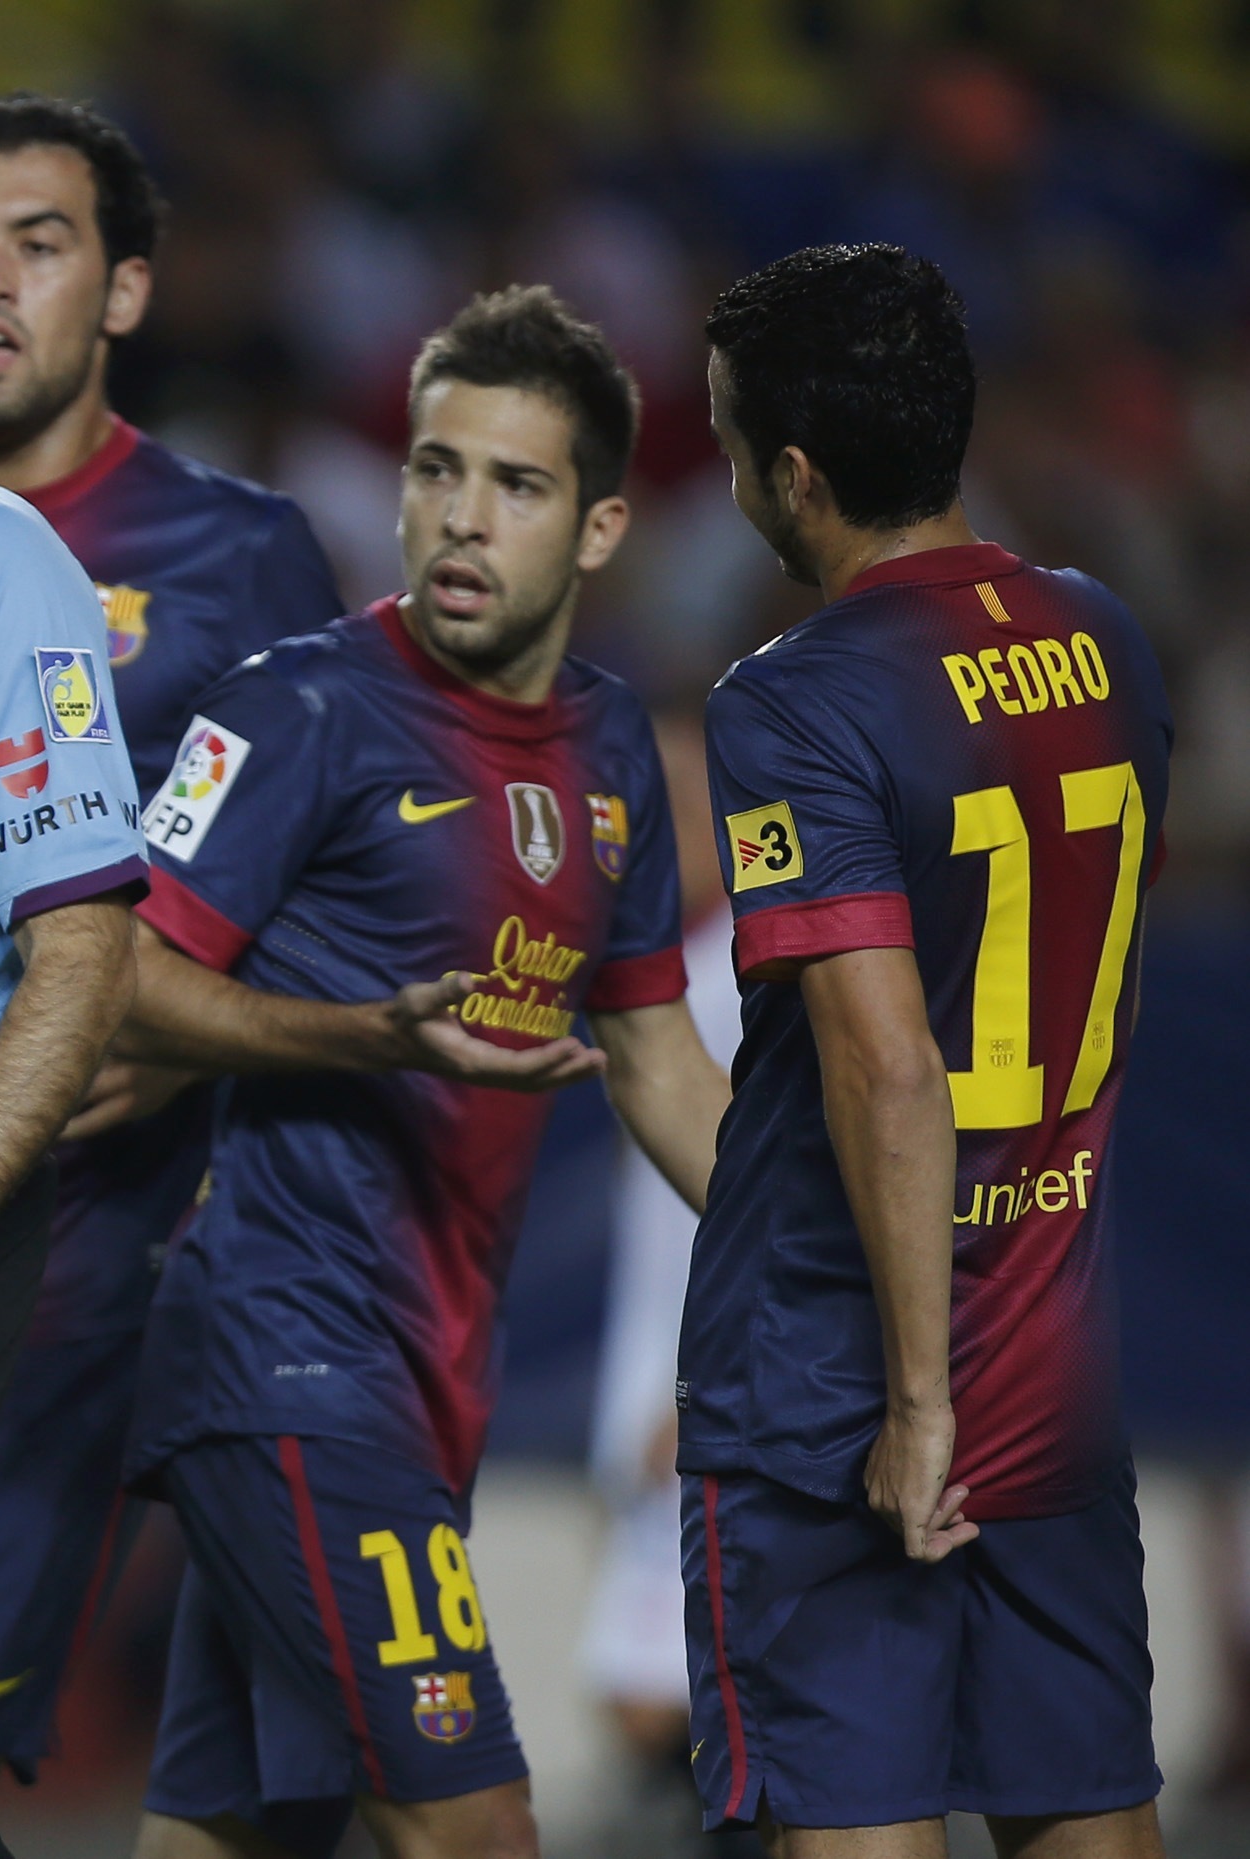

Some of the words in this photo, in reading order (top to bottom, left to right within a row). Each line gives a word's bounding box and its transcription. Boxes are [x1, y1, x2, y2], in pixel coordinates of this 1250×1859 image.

[942, 632, 1109, 724] PEDRO
[489, 915, 587, 991] Qatar
[948, 760, 1147, 1129] 17
[953, 1150, 1093, 1226] unicef
[359, 1522, 487, 1666] 18
